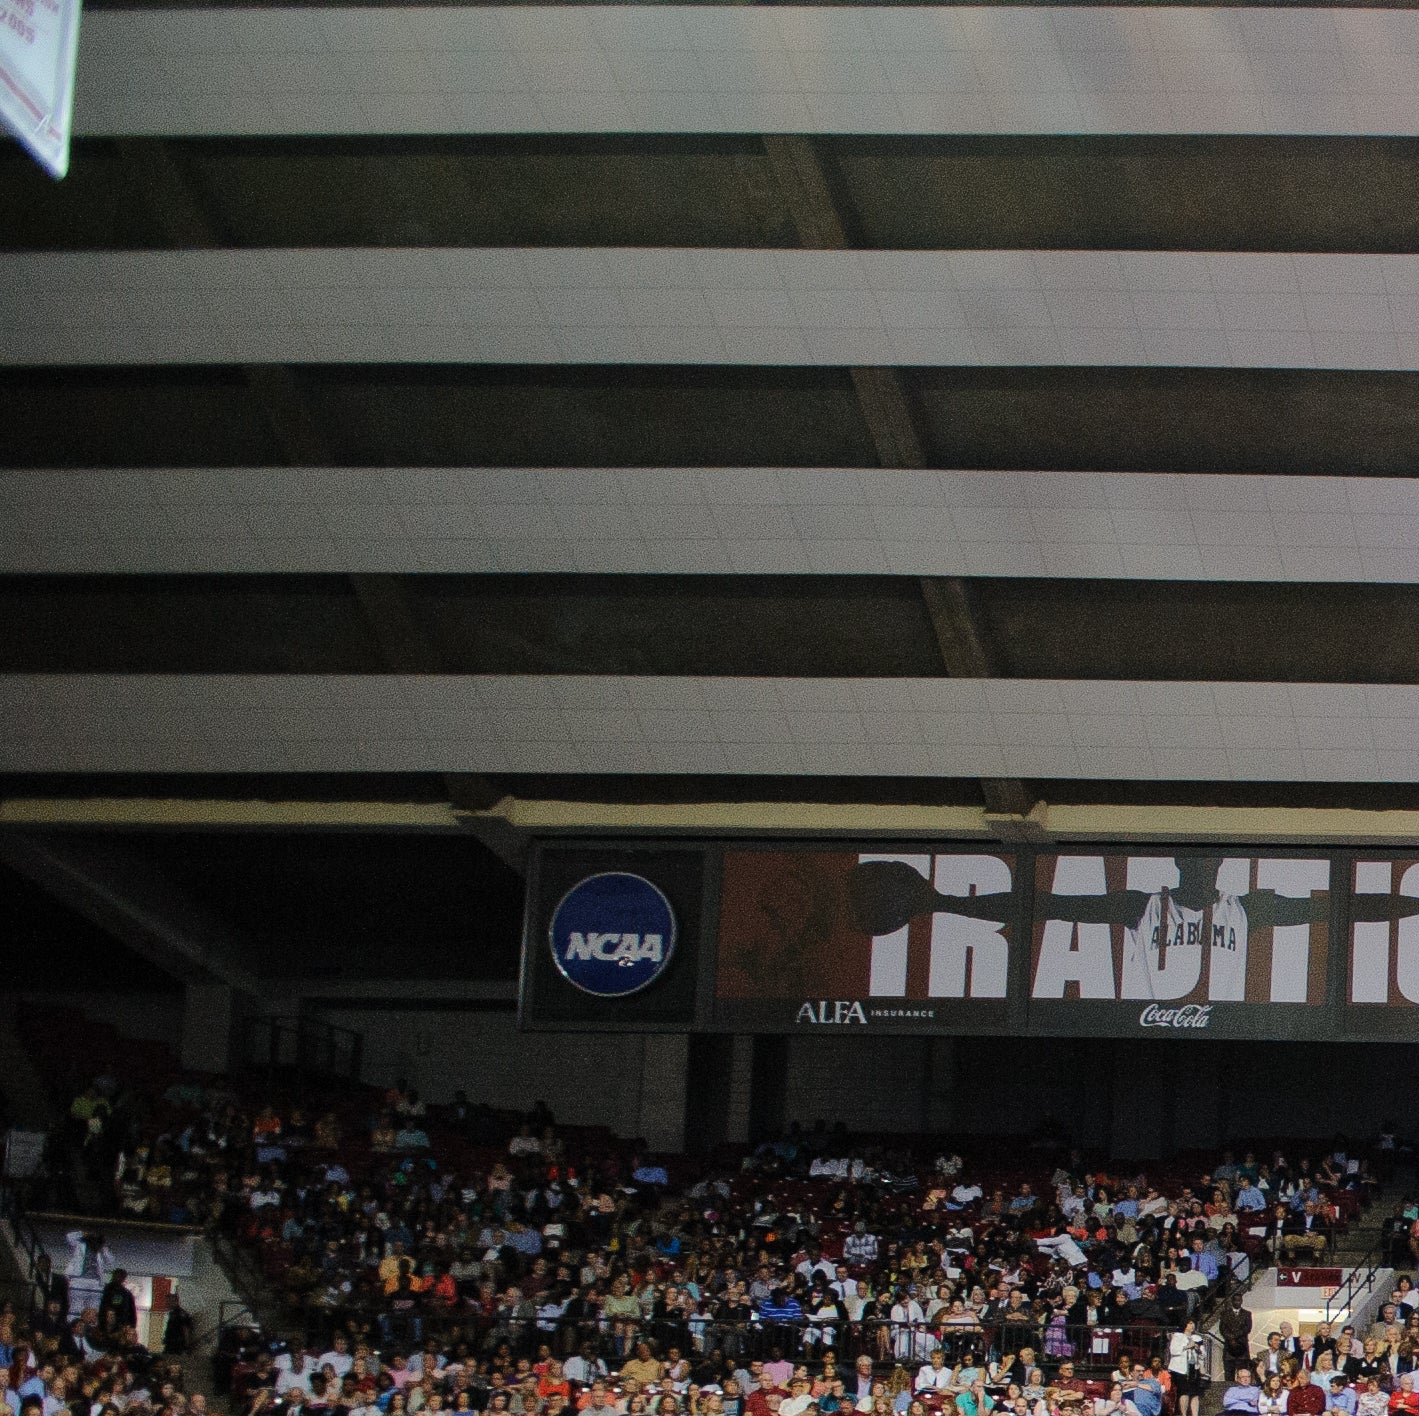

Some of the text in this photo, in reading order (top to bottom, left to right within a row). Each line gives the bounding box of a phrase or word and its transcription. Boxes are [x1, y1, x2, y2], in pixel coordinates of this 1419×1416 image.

[565, 931, 663, 964] NCAA
[1151, 921, 1236, 952] AABMA
[796, 1000, 935, 1025] ALFA INSURANCE
[1140, 1003, 1214, 1028] Coca-Cola
[1292, 1271, 1302, 1283] V
